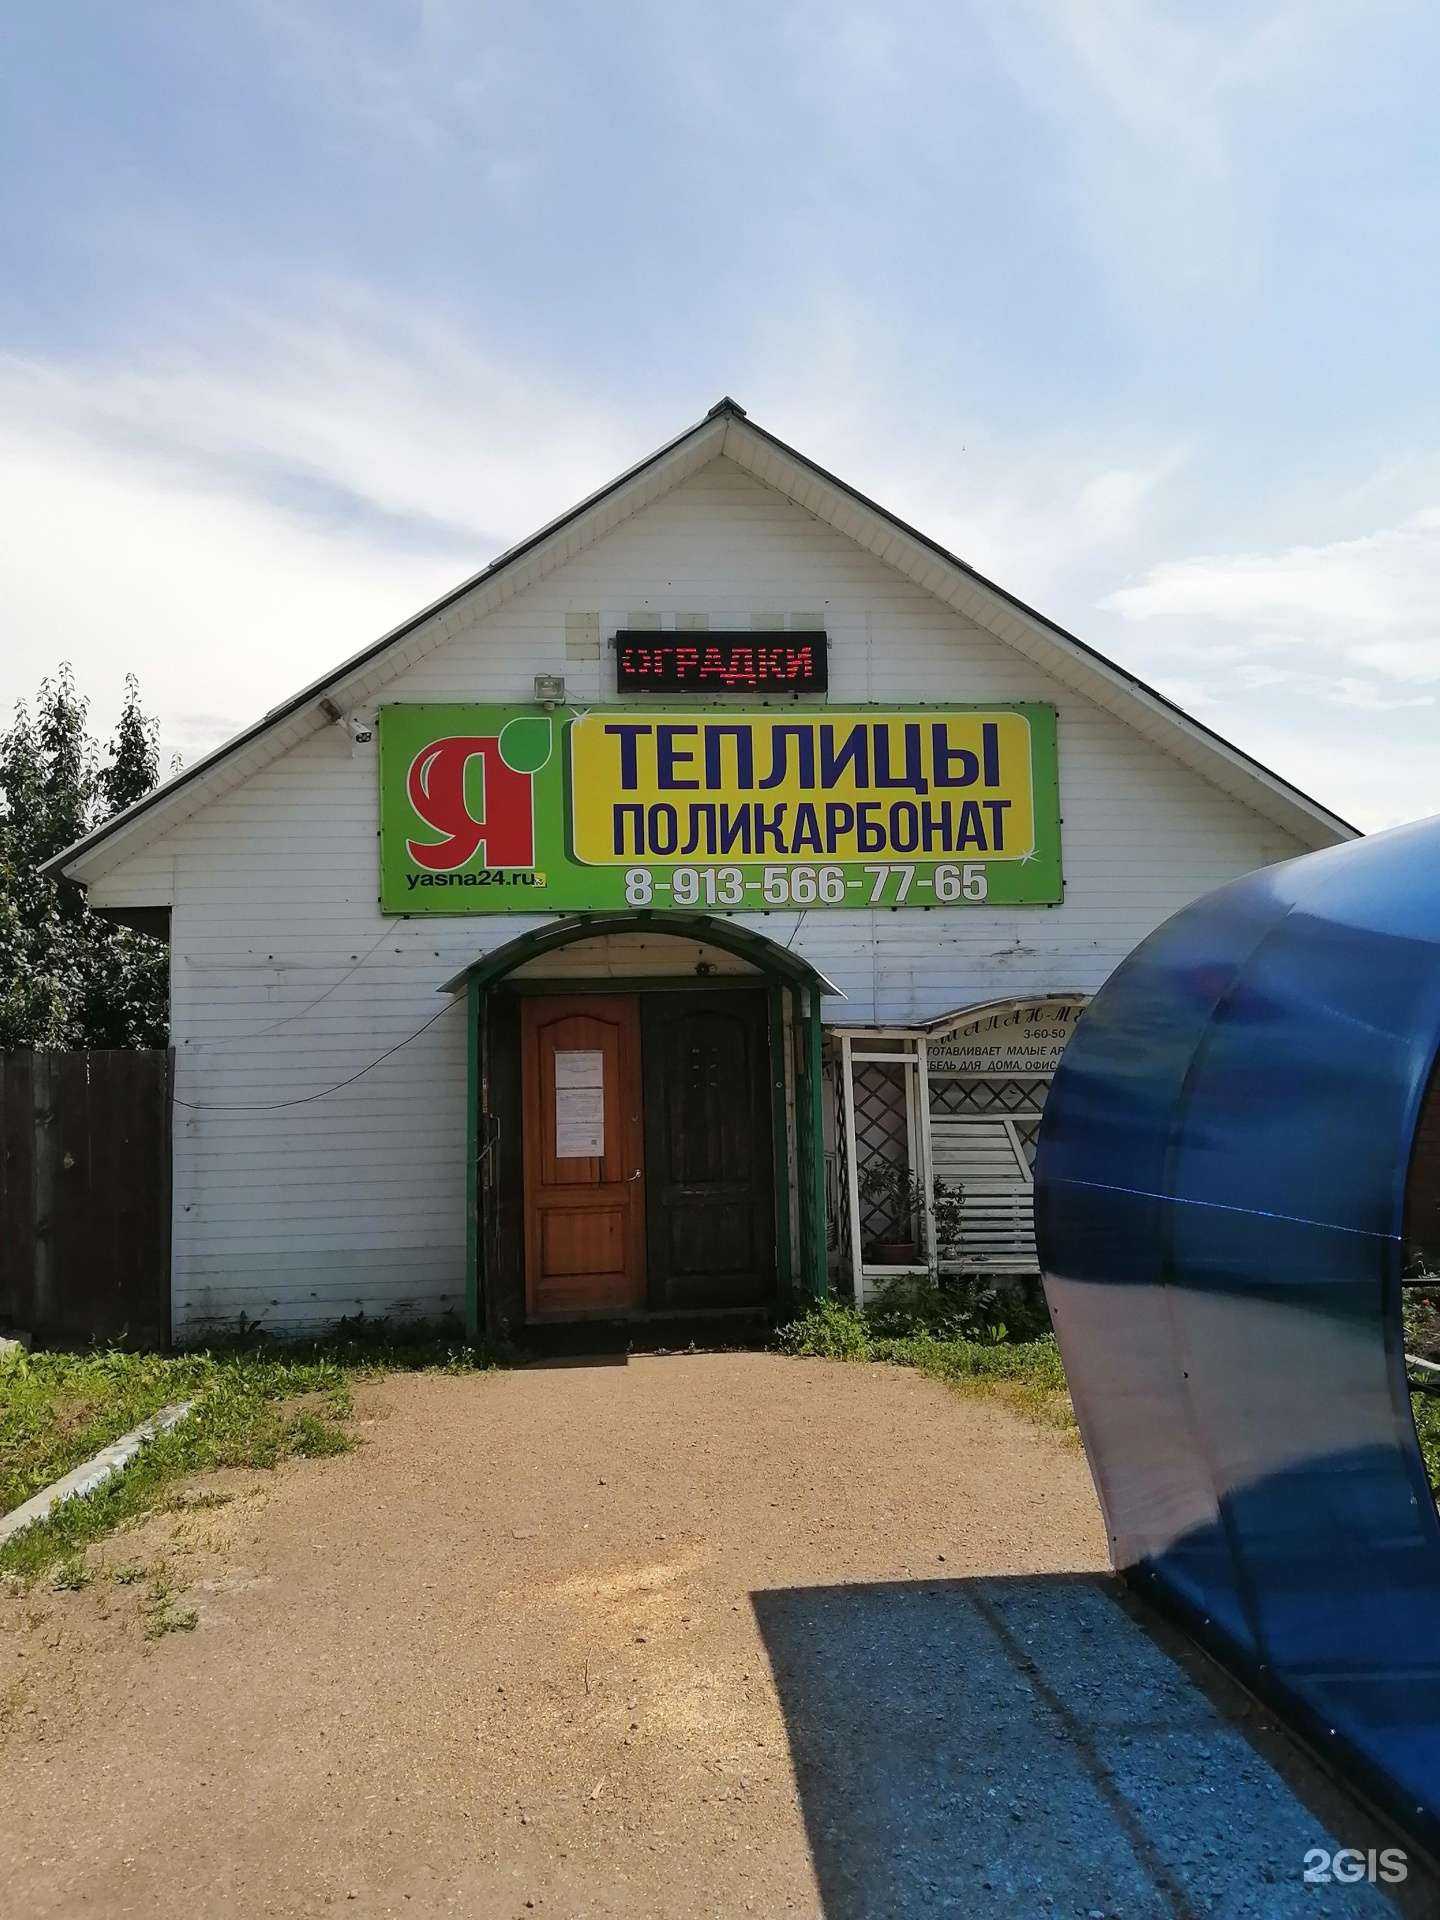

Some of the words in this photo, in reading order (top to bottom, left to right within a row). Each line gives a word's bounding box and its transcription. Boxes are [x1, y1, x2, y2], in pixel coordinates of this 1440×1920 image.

[622, 647, 813, 684] ОГРАДКИ
[604, 723, 1000, 795] ТЕПЛИЦЫ
[613, 800, 1012, 855] ПОЛИКАРБОНАТ
[406, 871, 536, 890] yasna24.ru
[624, 864, 989, 905] 8-913-566-77-65
[1024, 1029, 1066, 1039] 3-60-50
[1006, 1046, 1047, 1055] МАЛЫЕ
[959, 1061, 982, 1071] ДЛЯ
